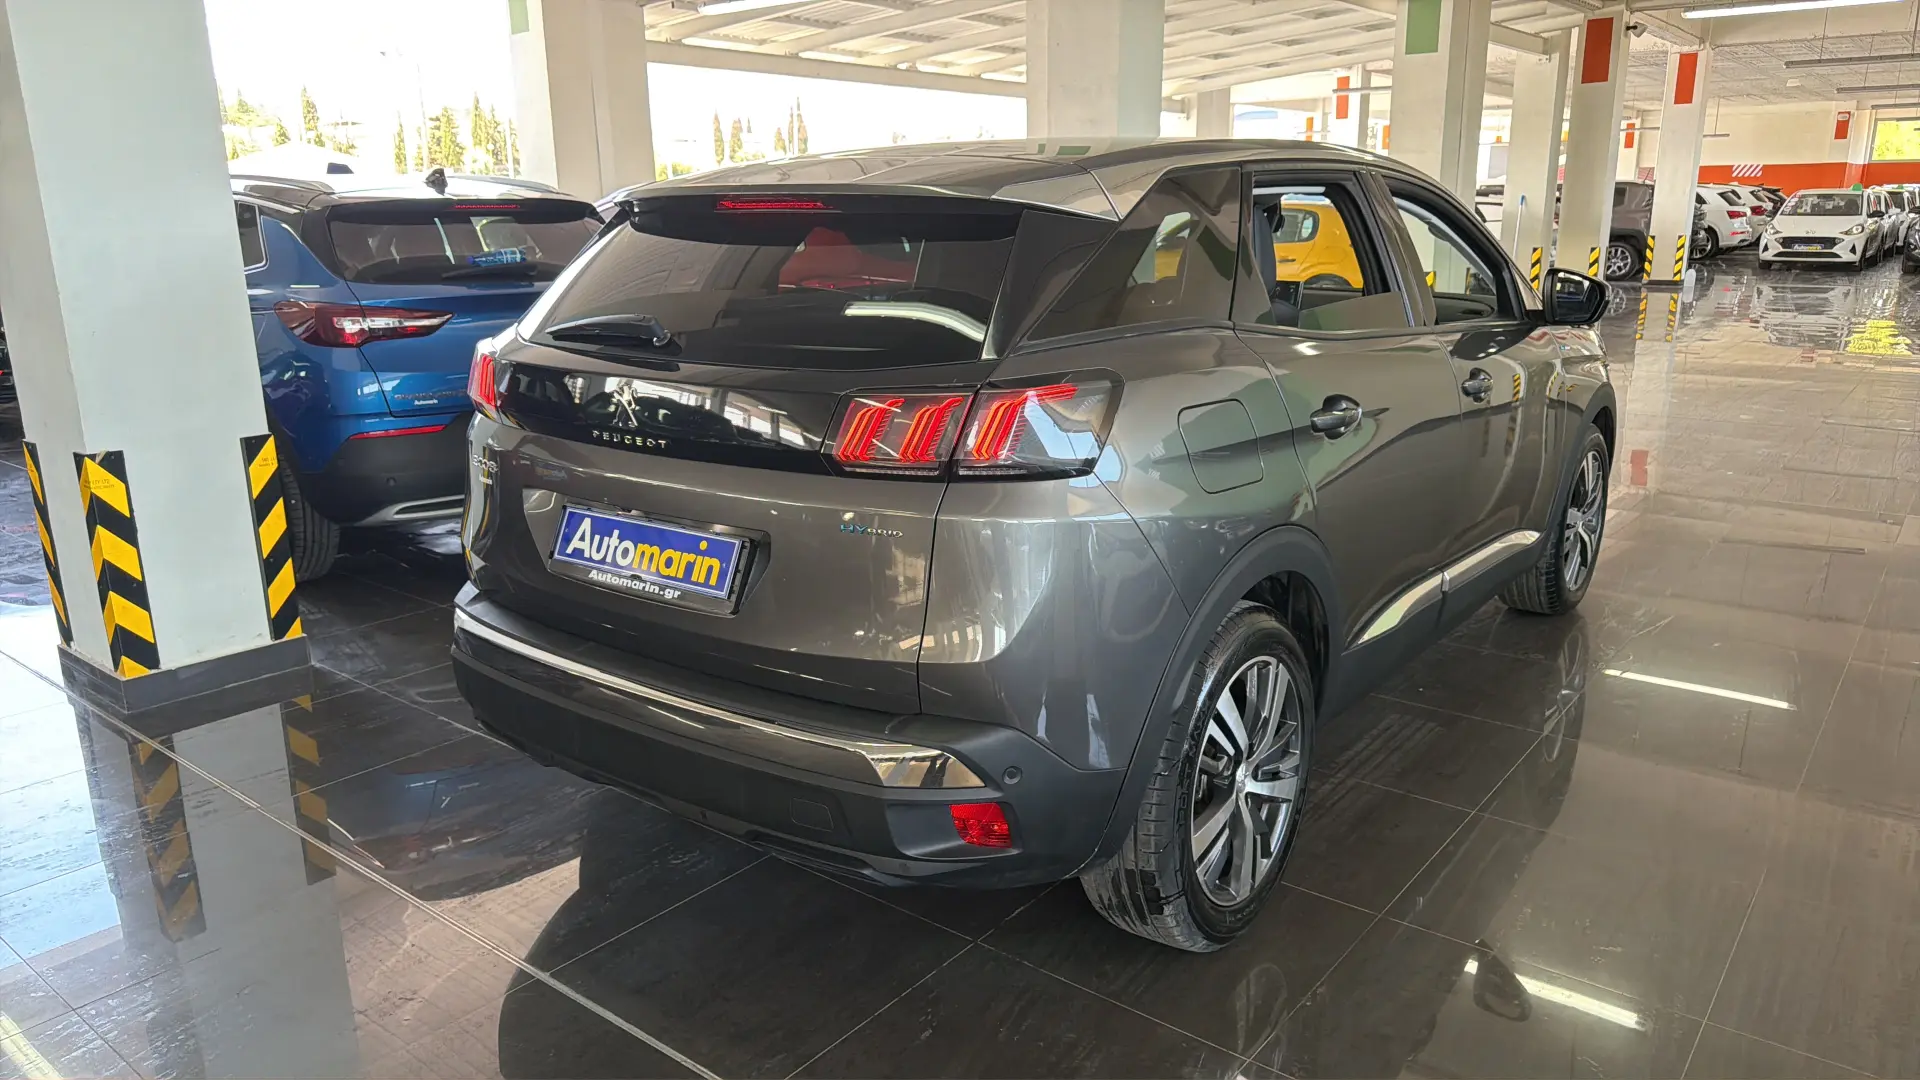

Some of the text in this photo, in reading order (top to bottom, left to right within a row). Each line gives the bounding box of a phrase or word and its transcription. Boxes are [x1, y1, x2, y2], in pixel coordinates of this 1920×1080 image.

[592, 429, 666, 449] PEUGEOT
[840, 523, 903, 538] HYBRID
[565, 517, 721, 586] Automarin
[588, 569, 681, 599] Automarin.gr
